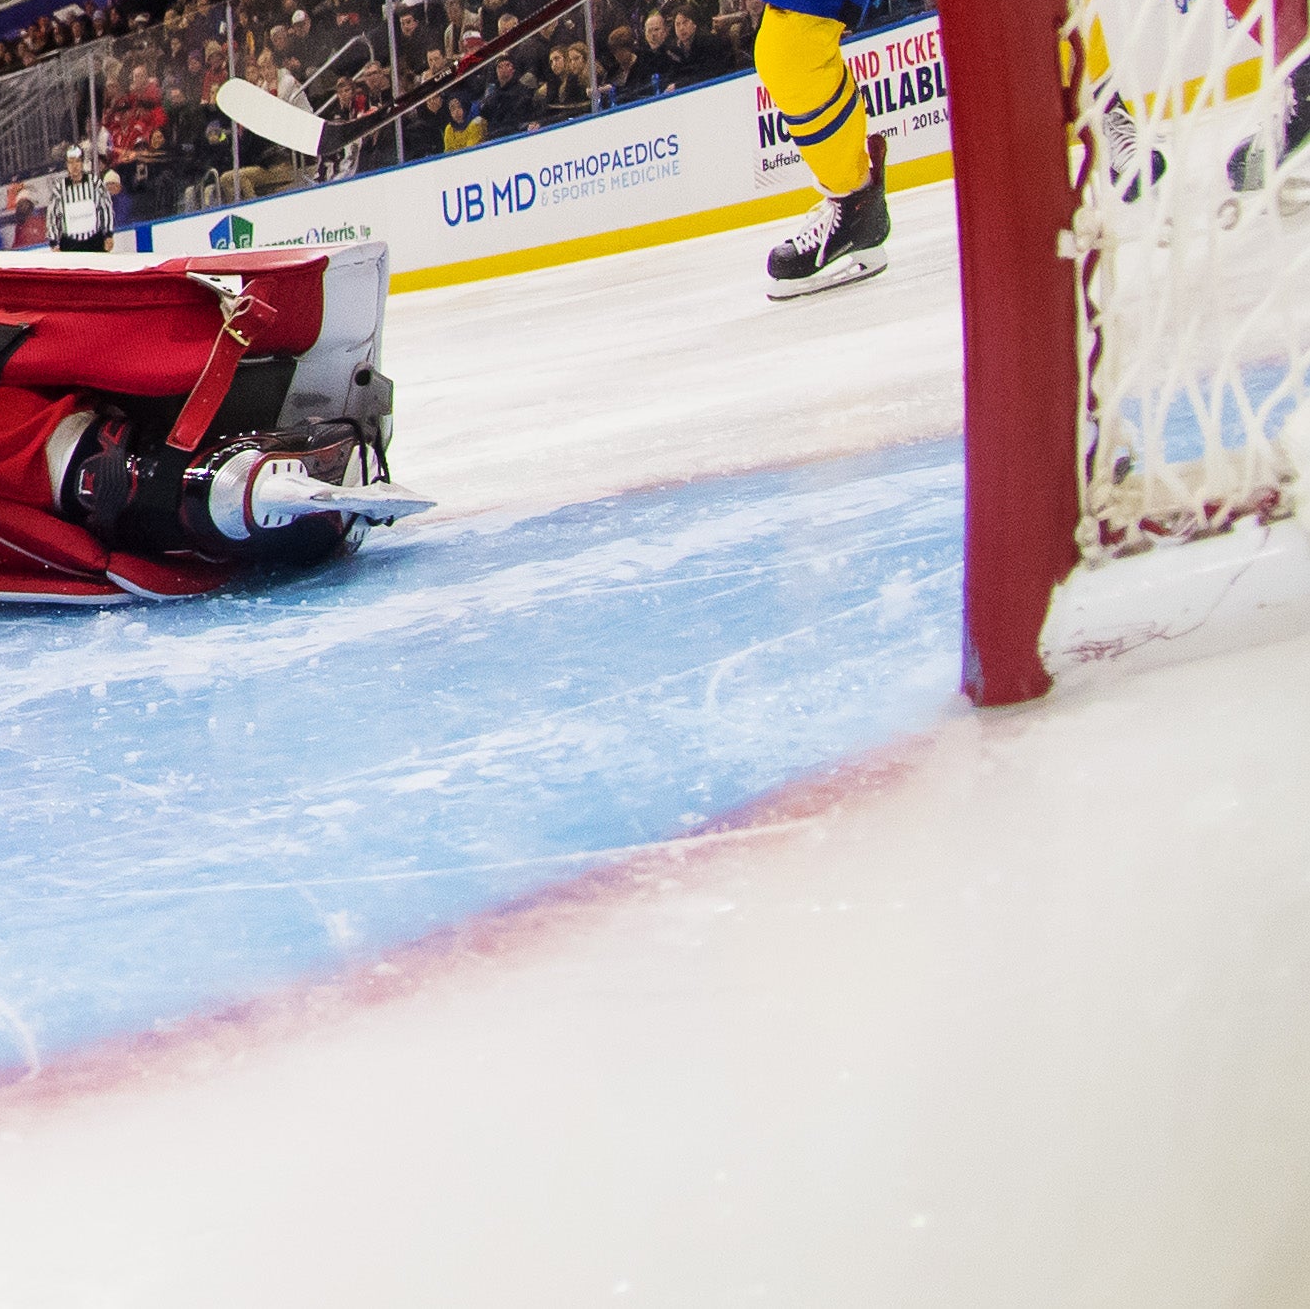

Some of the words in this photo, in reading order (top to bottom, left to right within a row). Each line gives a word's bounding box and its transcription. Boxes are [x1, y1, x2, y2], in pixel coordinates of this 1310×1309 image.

[539, 134, 680, 188] ORTHOPAEDICS
[552, 177, 606, 205] SPORTS
[610, 159, 681, 190] MEDICINE
[442, 183, 485, 227] UB
[493, 172, 536, 216] MD
